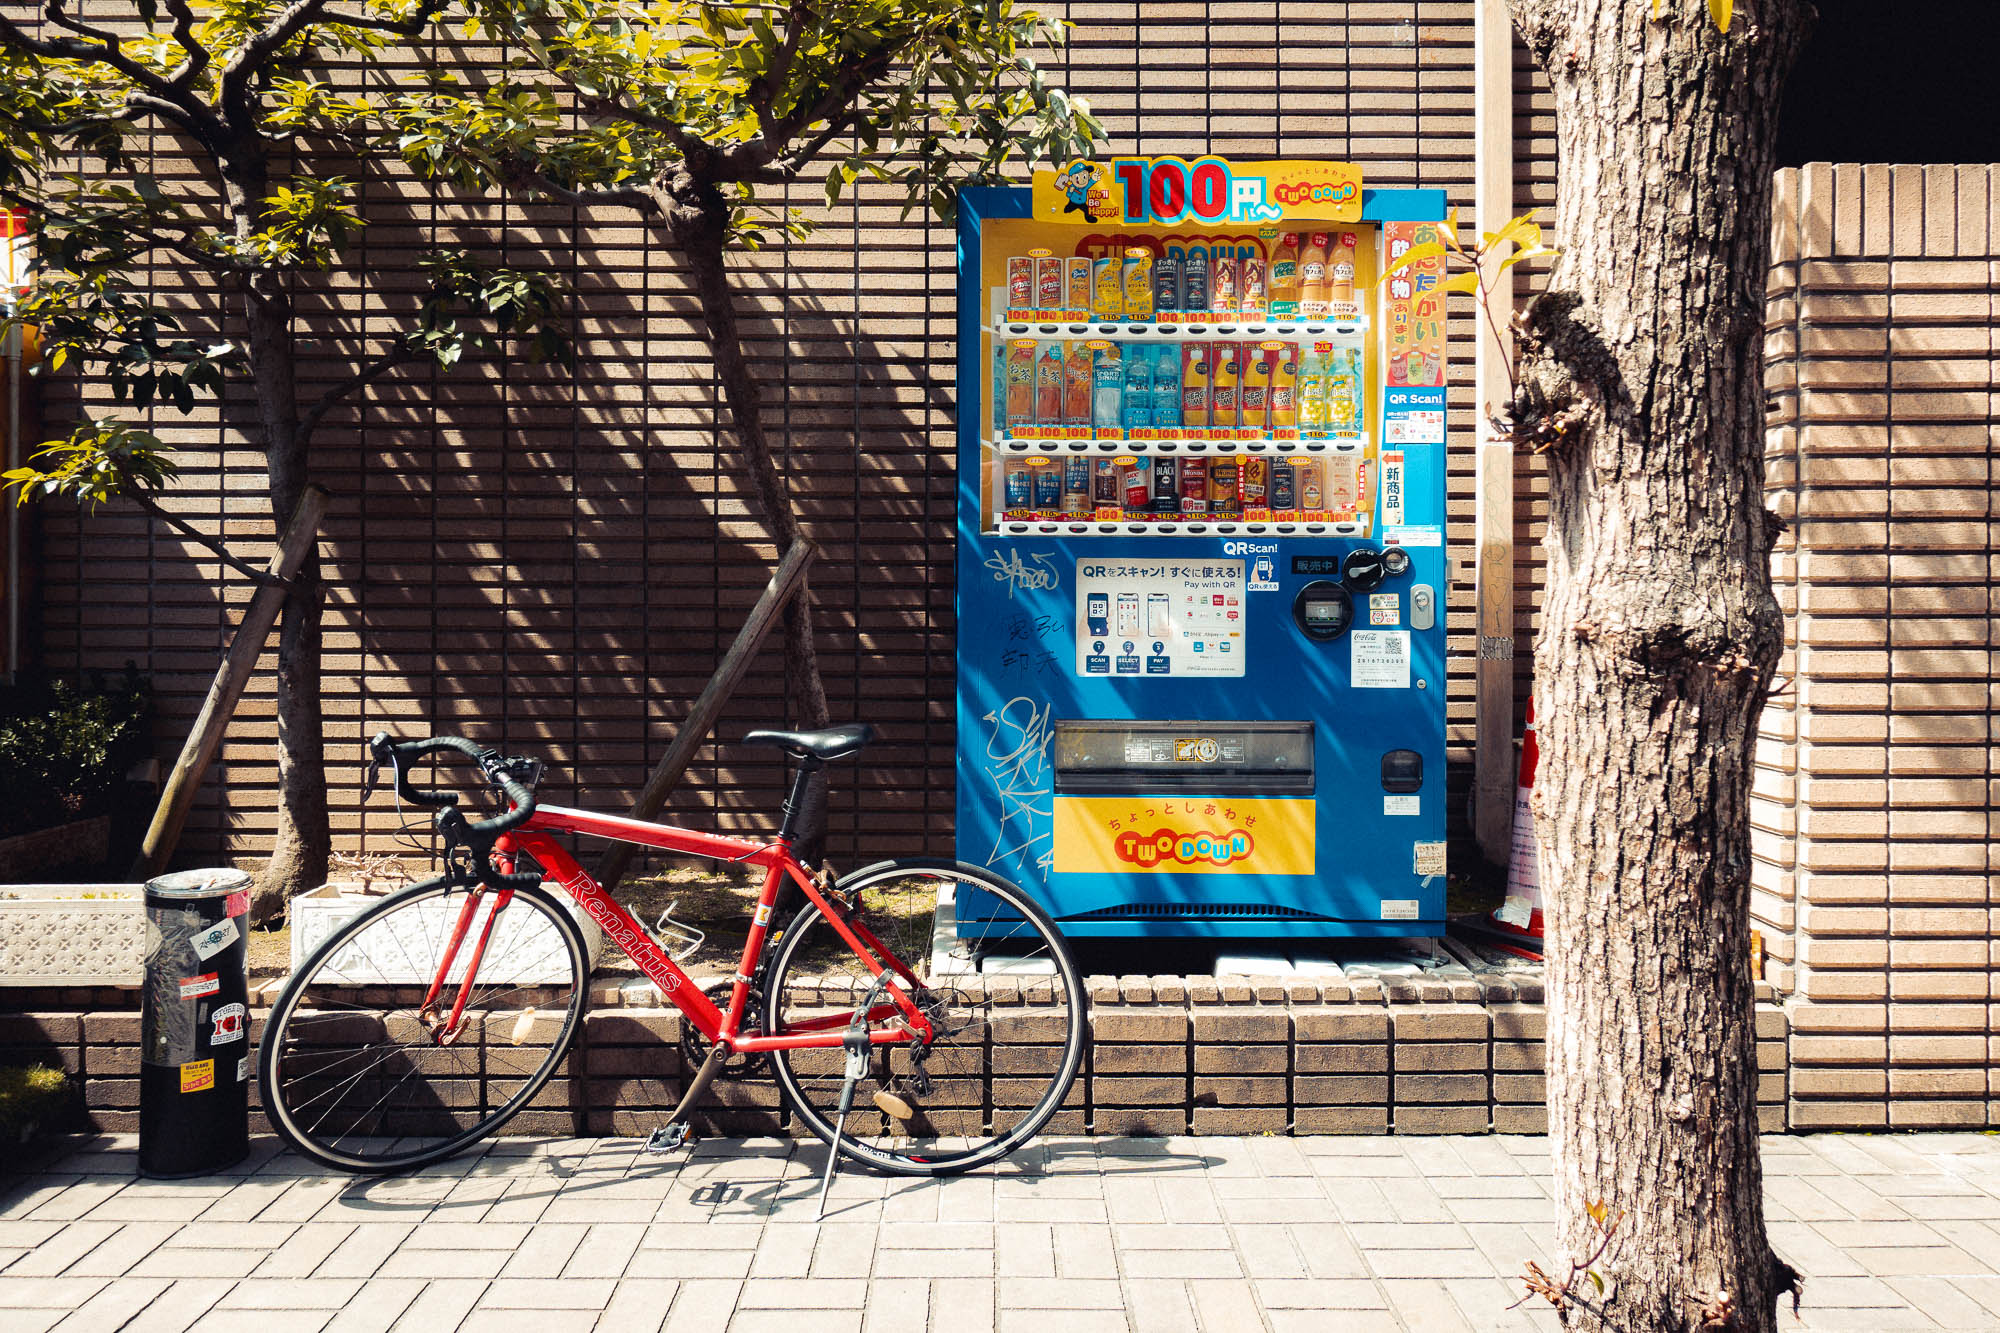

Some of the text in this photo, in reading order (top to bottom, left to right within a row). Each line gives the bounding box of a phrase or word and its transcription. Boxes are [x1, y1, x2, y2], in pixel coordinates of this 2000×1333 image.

[1088, 190, 1109, 198] We'll
[1313, 185, 1352, 200] DOWN
[1088, 207, 1119, 216] Happy!
[1007, 310, 1030, 320] 100
[1035, 311, 1057, 320] 100
[1062, 311, 1084, 321] 100
[1156, 313, 1178, 322] 100
[1184, 313, 1204, 322] 100
[1210, 312, 1232, 322] 100
[1239, 312, 1261, 322] 100
[1394, 303, 1408, 344] あります
[1009, 363, 1031, 381] お茶
[1039, 366, 1061, 382] 麦茶
[1389, 394, 1443, 405] QR Scan!
[1013, 427, 1035, 437] 100
[1039, 428, 1061, 437] 100
[1065, 428, 1088, 438] 100
[1097, 429, 1119, 438] 100
[1130, 429, 1152, 438] 100
[1157, 429, 1179, 438] 100
[1181, 429, 1204, 438] 100
[1208, 429, 1231, 438] 100
[1236, 429, 1259, 438] 100
[1273, 429, 1296, 438] 100
[1156, 466, 1175, 476] BLACK
[1386, 467, 1400, 509] 新商品
[1223, 541, 1278, 555] QR Scan!
[1297, 559, 1333, 571] 販売中
[1082, 565, 1241, 579] QRをスキャン! すぐに使える!
[1184, 581, 1198, 589] Pay
[1108, 801, 1257, 832] ちょっとしあわせ
[1123, 835, 1246, 862] TWO DOWN
[560, 870, 682, 993] Renatus
